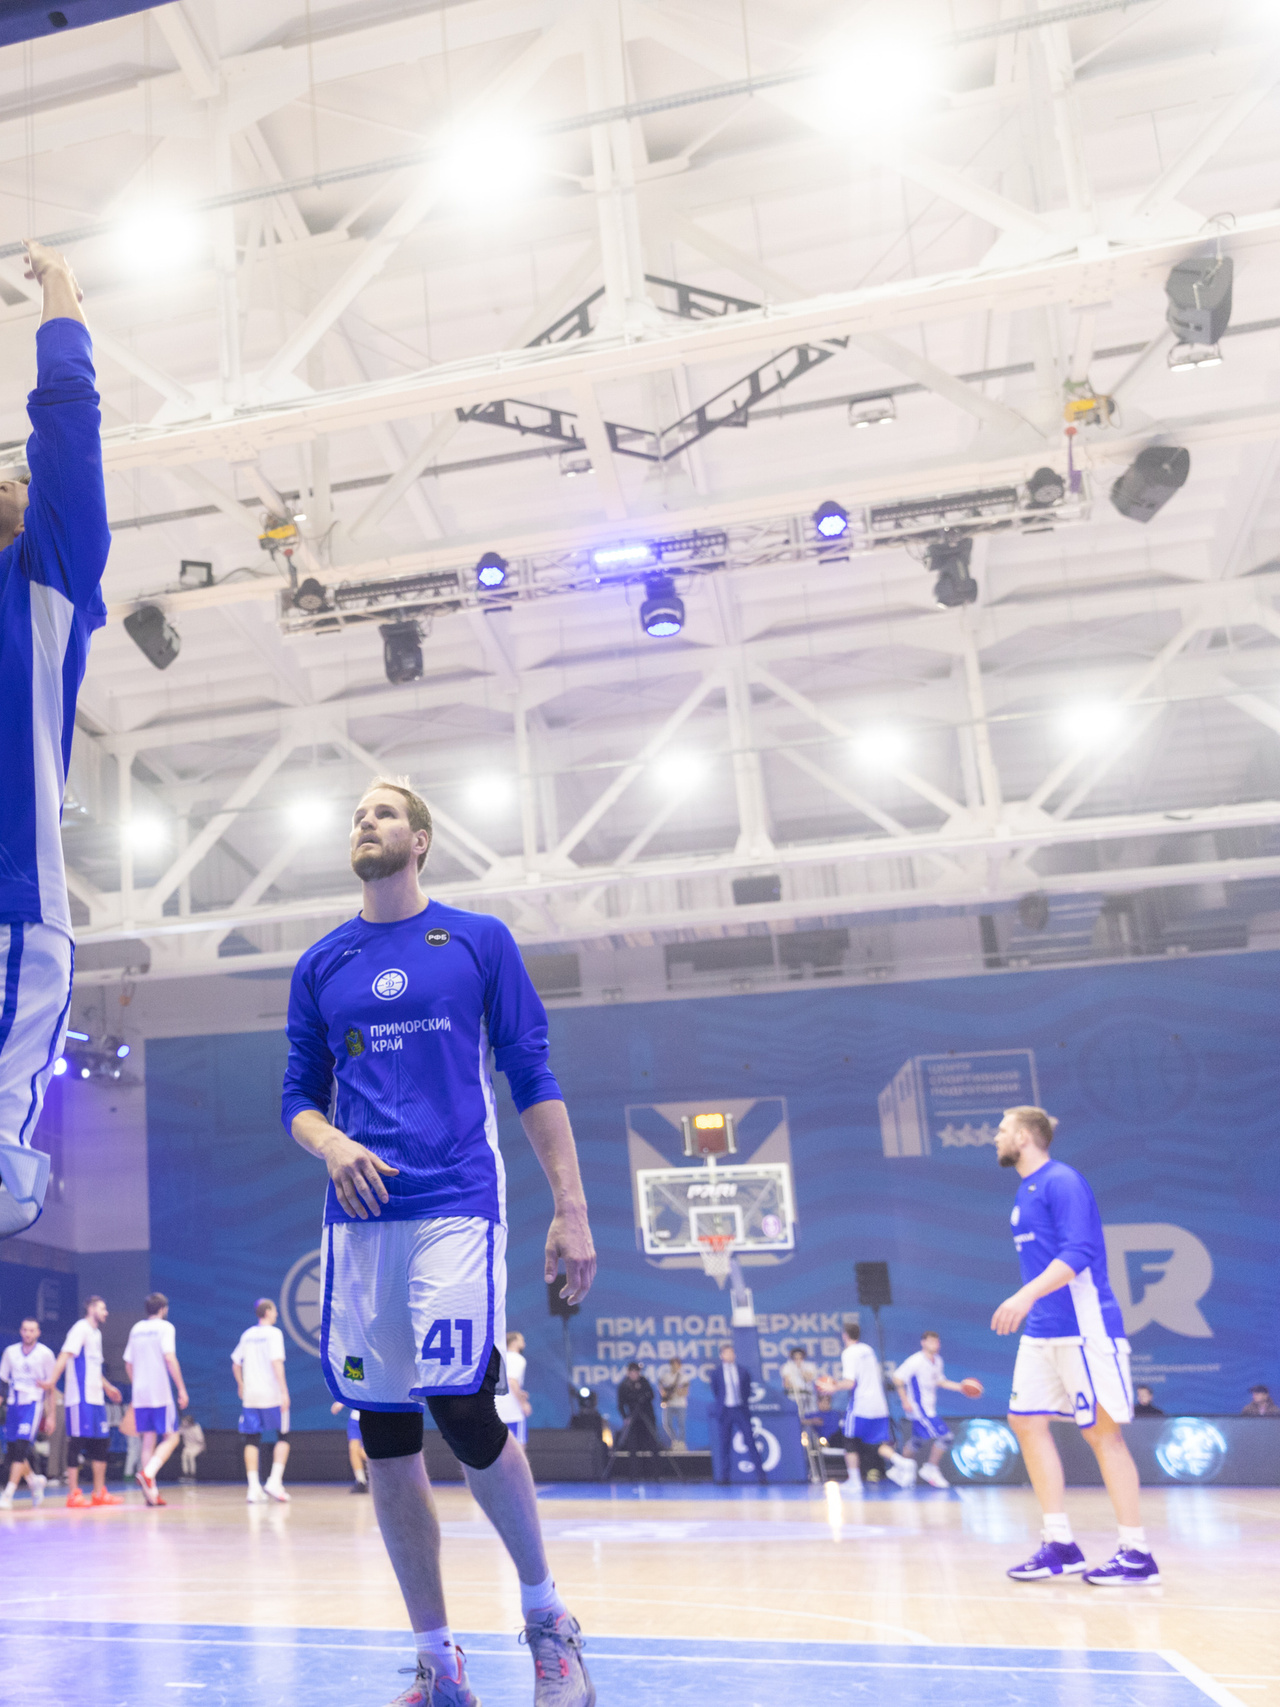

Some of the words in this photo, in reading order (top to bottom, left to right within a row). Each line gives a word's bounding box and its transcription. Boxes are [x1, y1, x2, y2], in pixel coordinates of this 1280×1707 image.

[428, 933, 448, 942] РФБ
[370, 1016, 452, 1038] ПРИМОРСКИЙ
[371, 1035, 403, 1053] КРАЙ
[596, 1316, 656, 1337] ПРИ
[663, 1311, 860, 1337] ПОДЕРЖКЕ
[422, 1319, 473, 1366] 41
[597, 1336, 842, 1360] ПРАВИТЬСТВ
